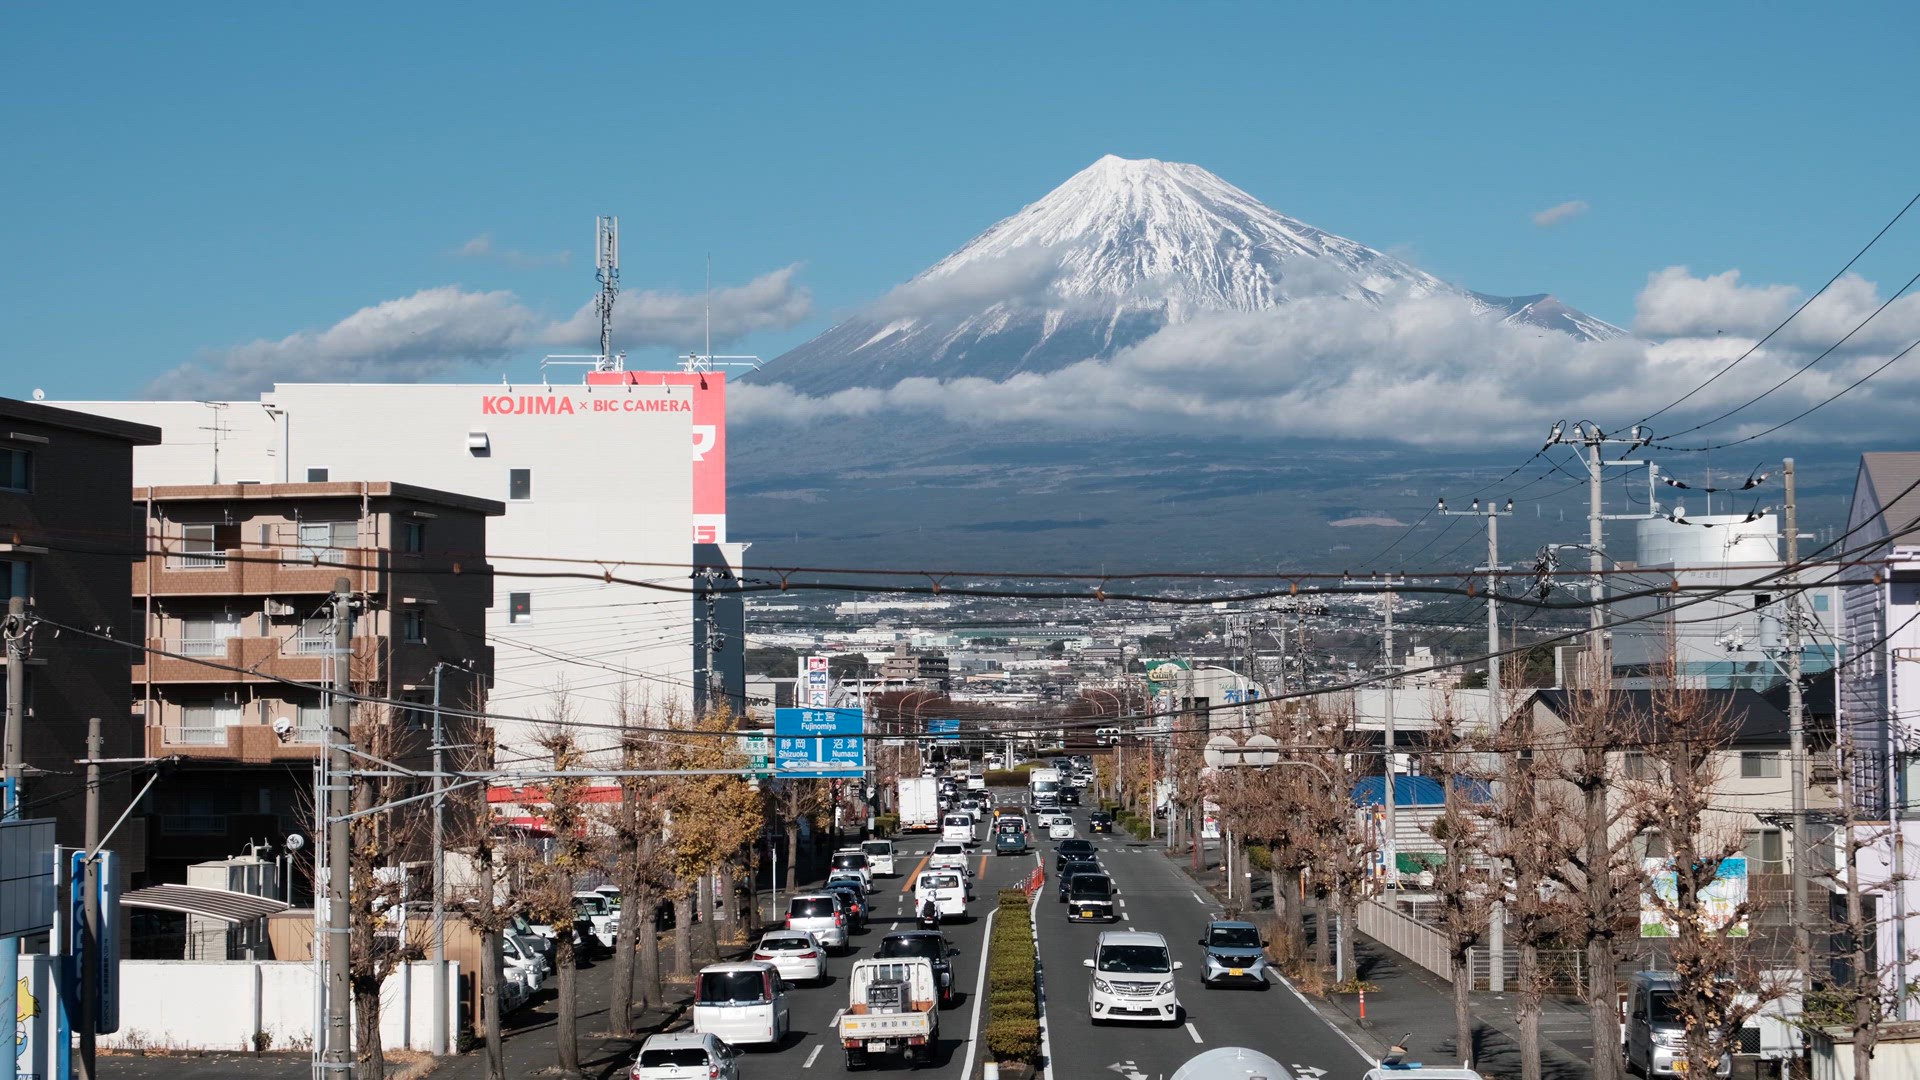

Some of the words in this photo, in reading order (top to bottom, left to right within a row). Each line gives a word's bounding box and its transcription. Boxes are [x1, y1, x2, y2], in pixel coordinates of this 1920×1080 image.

[482, 396, 575, 415] KOJIMA
[593, 399, 619, 412] BIC
[623, 399, 691, 412] CAMERA
[802, 711, 836, 722] 富士宮
[801, 723, 837, 732] Fujinomiya
[780, 739, 806, 749] 静岡
[833, 739, 858, 749] 沼津
[778, 750, 808, 758] Shizuoka
[832, 750, 859, 758] Numazu
